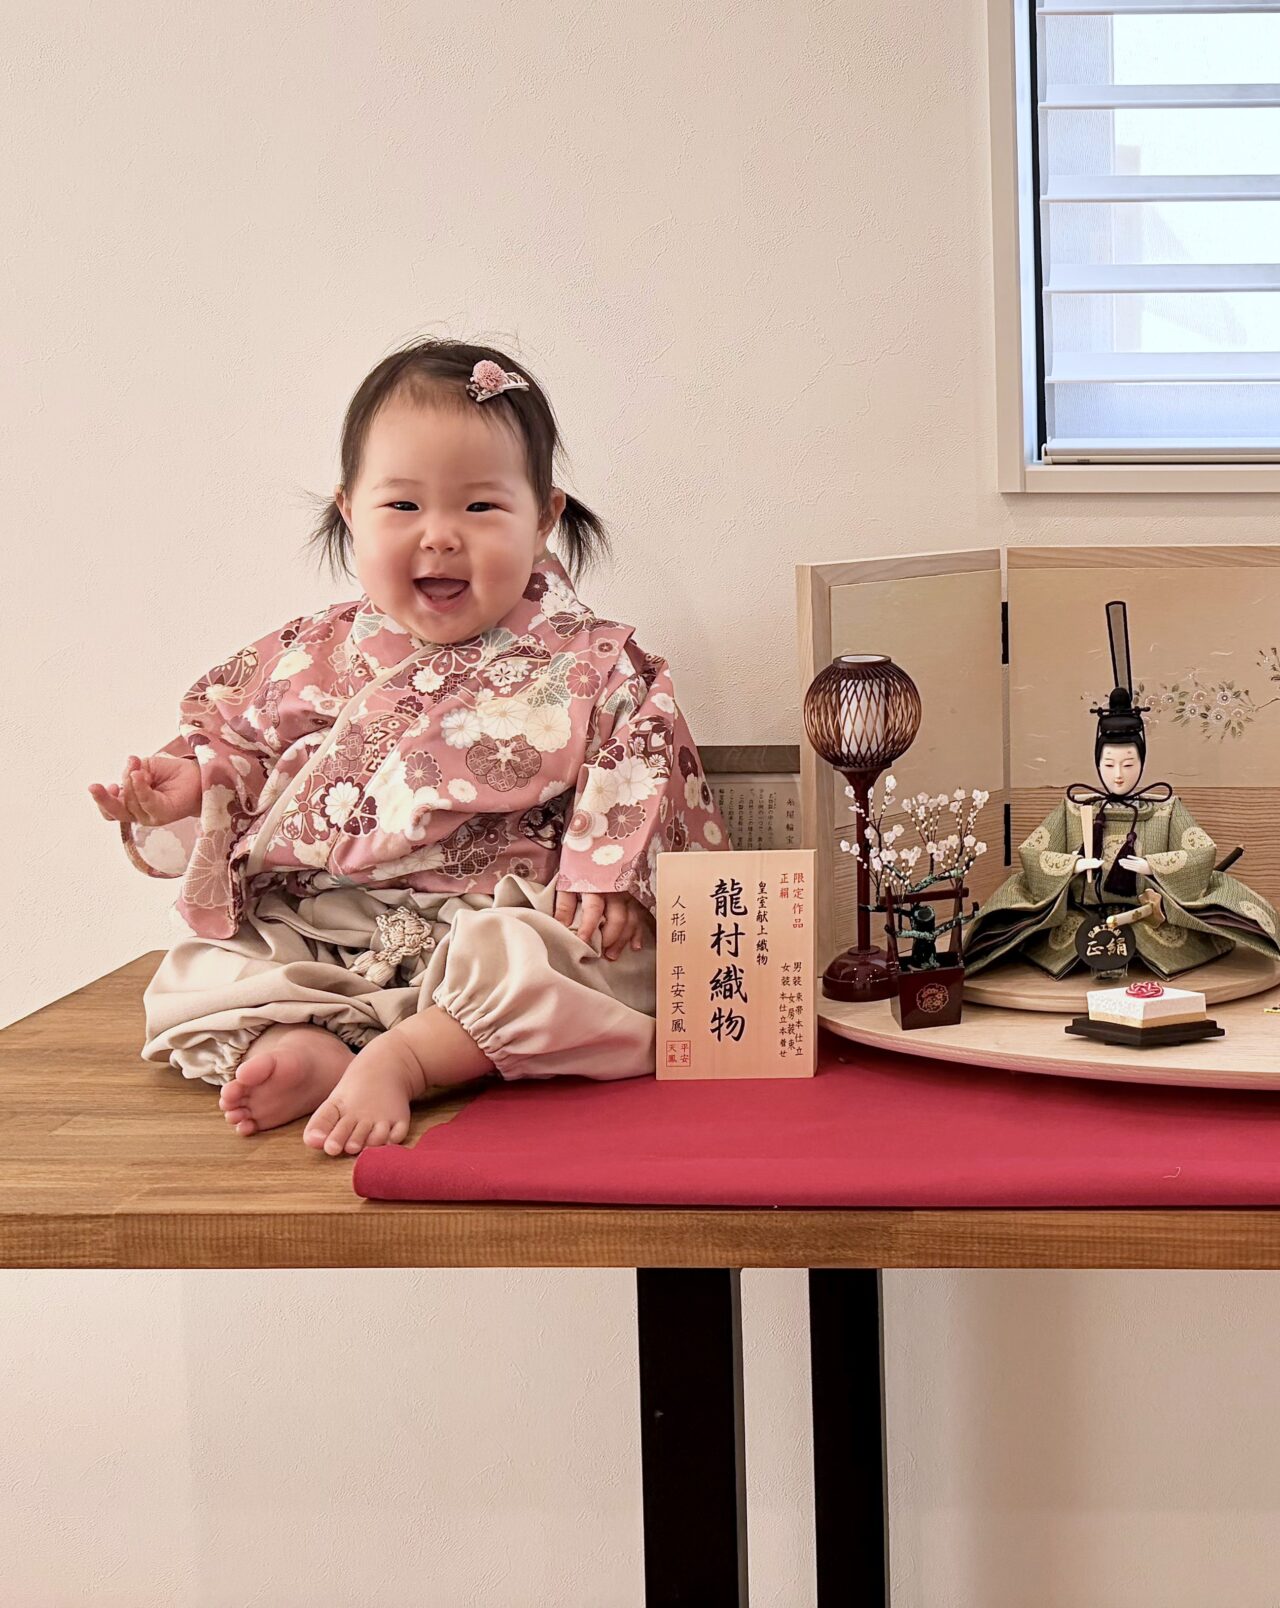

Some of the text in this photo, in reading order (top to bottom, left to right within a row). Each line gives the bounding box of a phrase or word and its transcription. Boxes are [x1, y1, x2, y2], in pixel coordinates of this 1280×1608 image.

[671, 895, 687, 945] 人形師
[756, 881, 768, 966] 皇室献上織物
[792, 872, 805, 929] 限定作品
[709, 878, 748, 1042] 龍村織物
